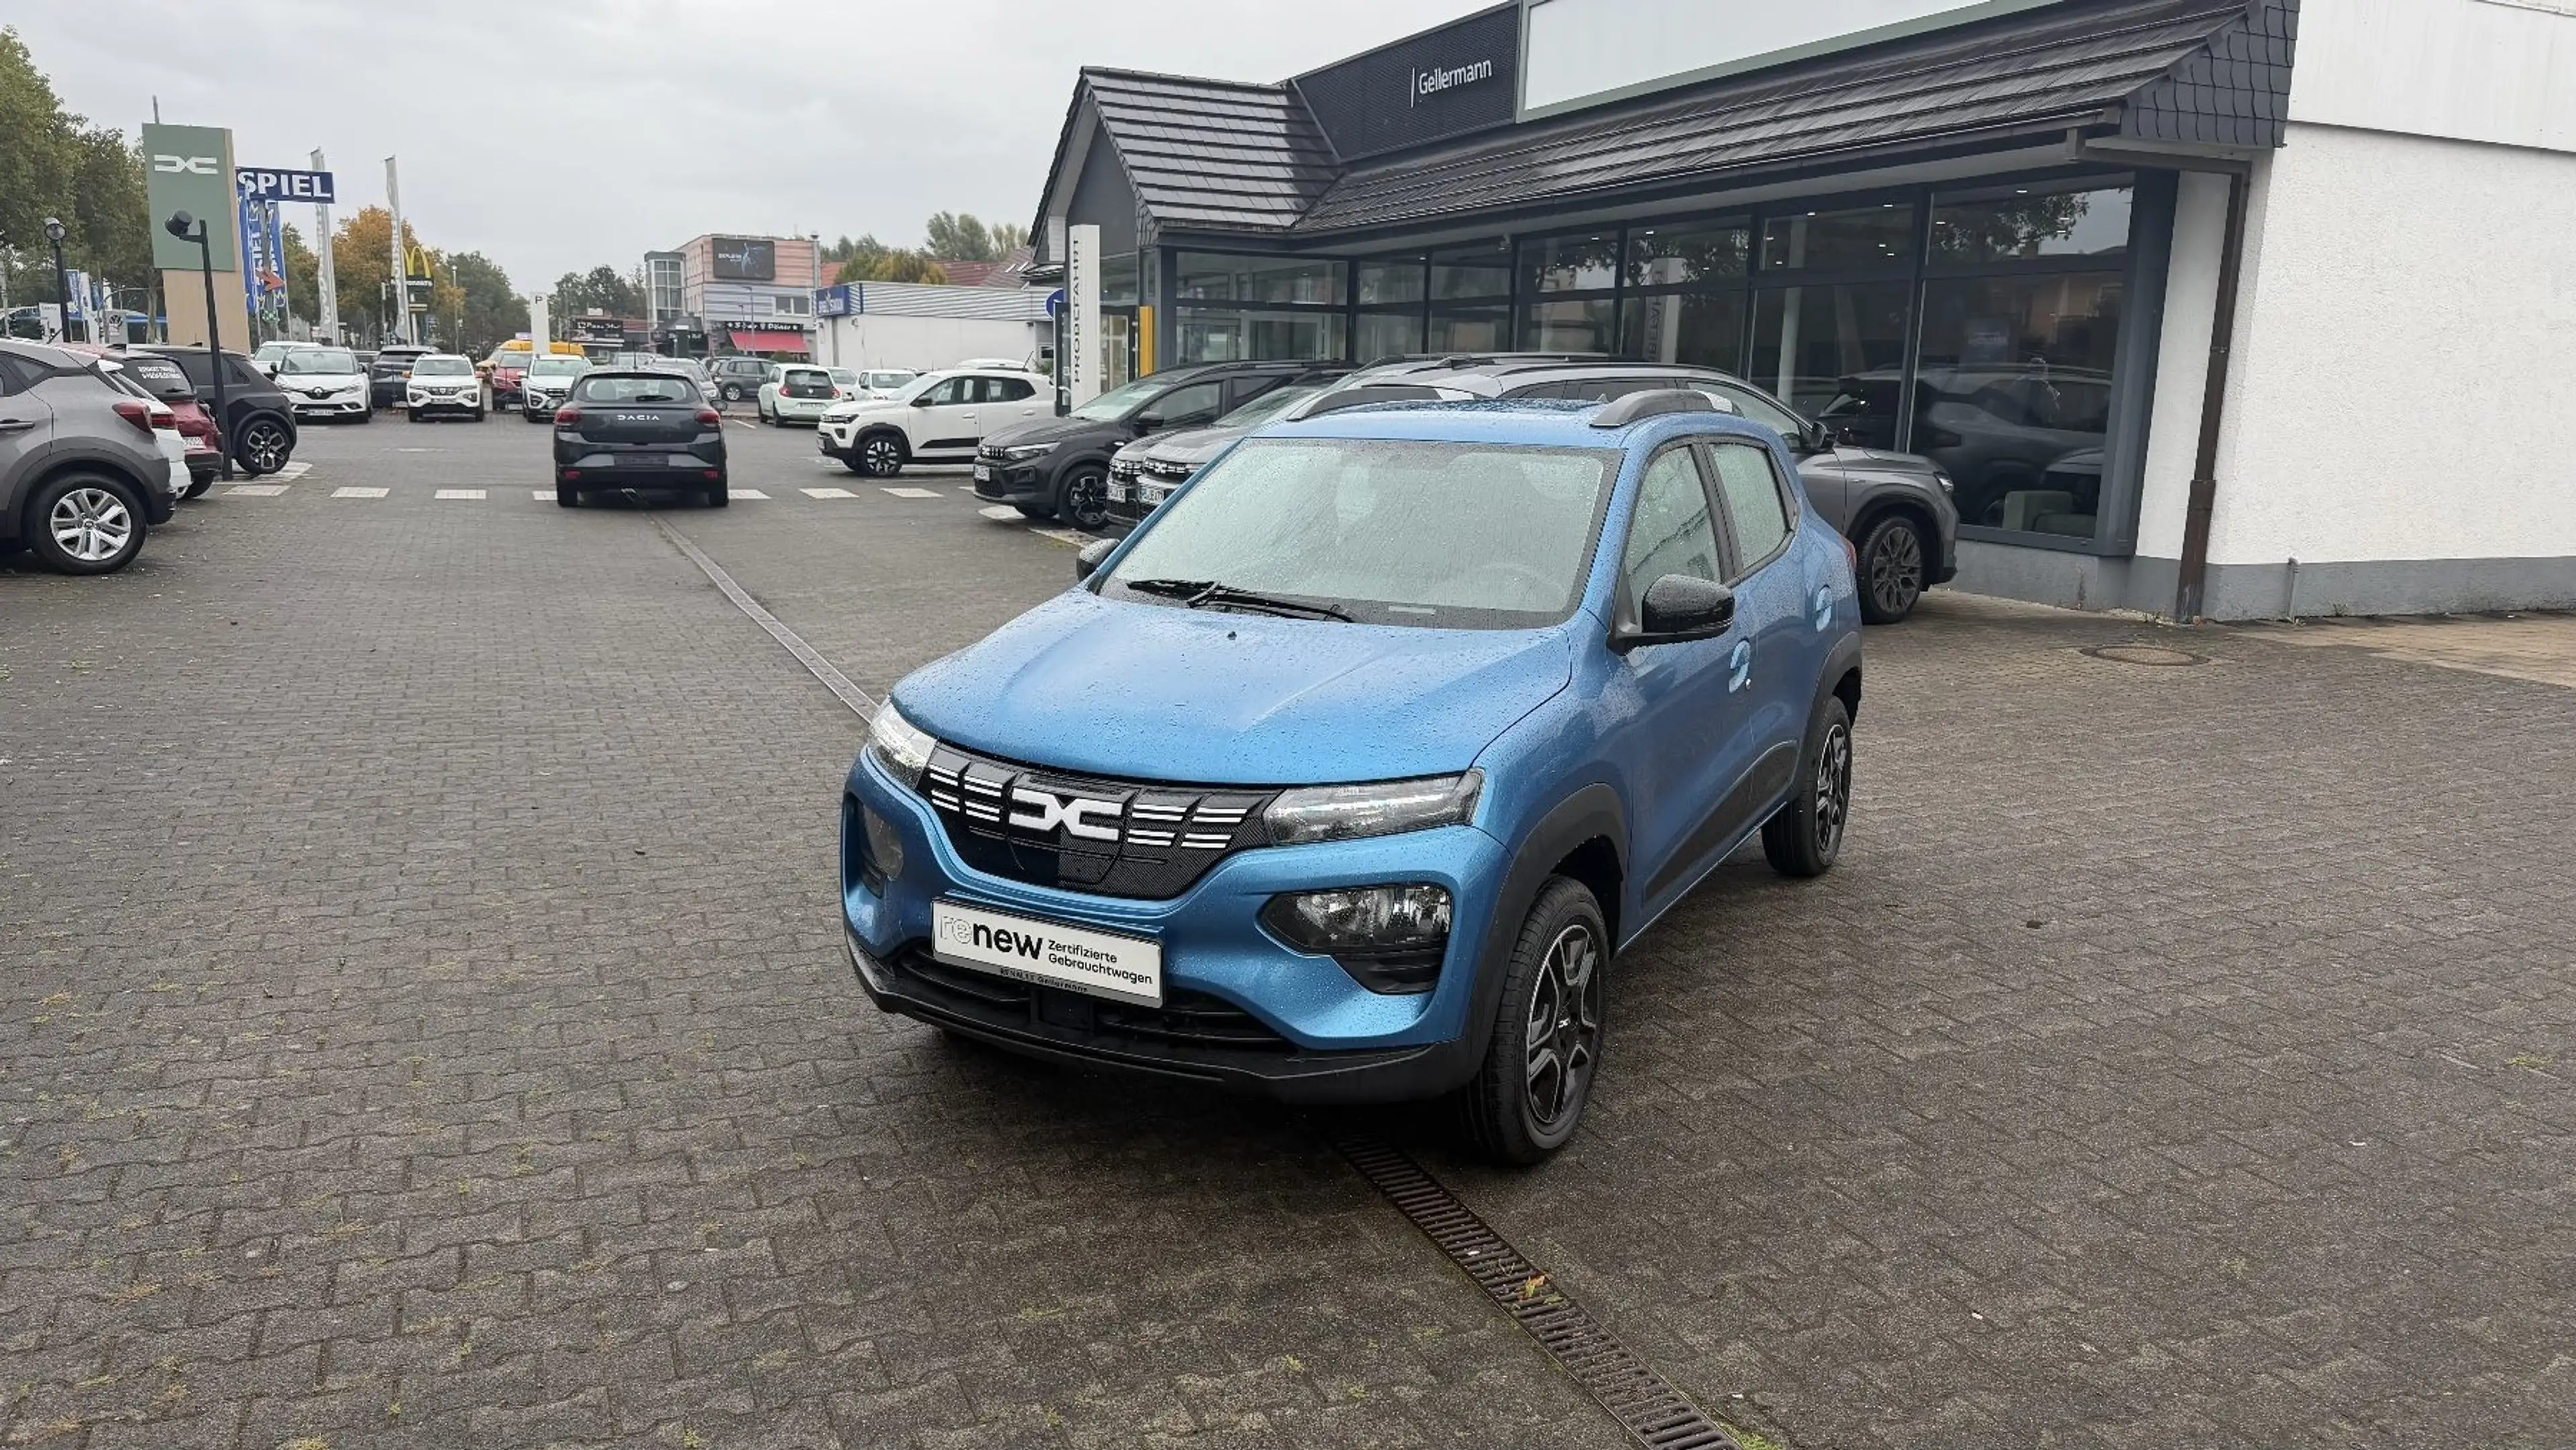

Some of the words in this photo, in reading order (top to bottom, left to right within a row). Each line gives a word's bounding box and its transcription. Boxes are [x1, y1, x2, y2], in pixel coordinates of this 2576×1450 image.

[1419, 59, 1493, 95] Gellermann
[237, 171, 332, 198] SPIEL
[535, 295, 543, 304] P
[941, 916, 1043, 960] renew
[1049, 939, 1118, 963] Zertifizierte
[1049, 953, 1152, 984] Gebrauchtwagen
